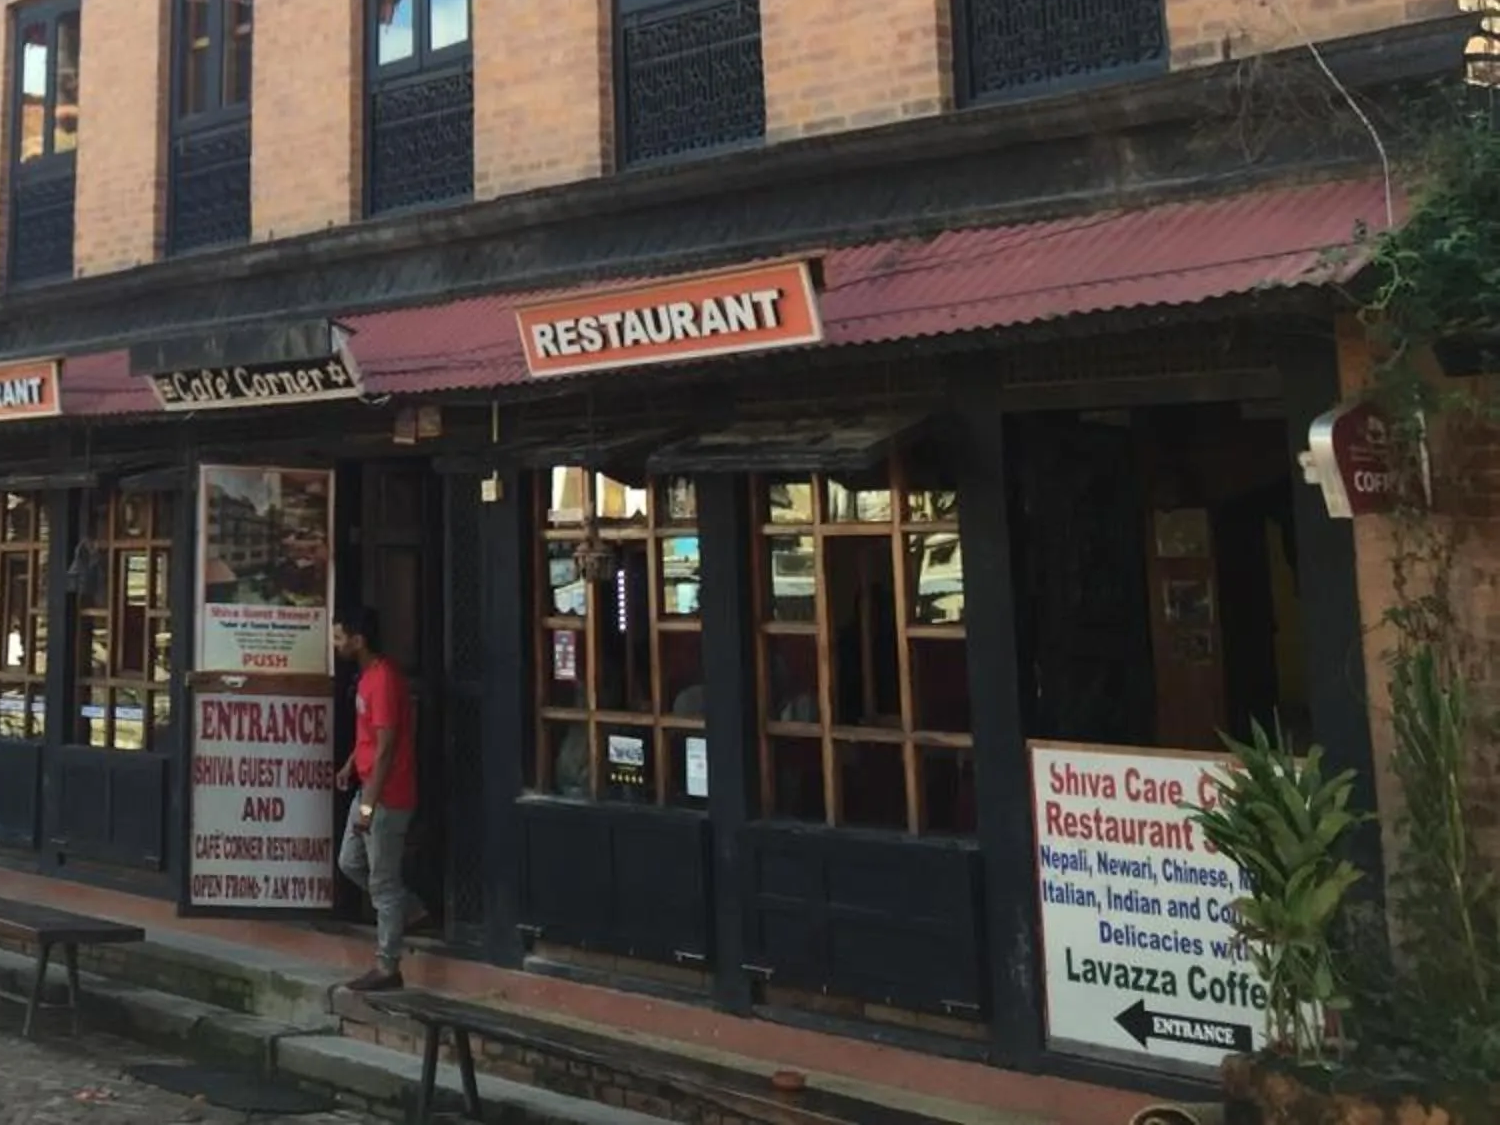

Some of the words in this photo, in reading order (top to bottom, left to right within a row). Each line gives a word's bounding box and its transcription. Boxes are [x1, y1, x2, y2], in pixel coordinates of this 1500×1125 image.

[531, 288, 781, 358] RESTAURANT
[234, 366, 323, 397] Corner
[243, 653, 288, 668] PUSH
[200, 701, 328, 744] ENTRANCE
[193, 755, 235, 787] SHIVA
[239, 758, 284, 788] GUEST
[287, 759, 334, 790] HOUSE
[1050, 763, 1116, 800] Shiva
[241, 796, 285, 822] AND
[1045, 800, 1194, 852] Restaurant
[194, 874, 222, 899] OPEN
[1040, 845, 1092, 878] Nepali,
[1097, 851, 1158, 886] Newari,
[1162, 858, 1233, 893] Chinese,
[1043, 880, 1101, 914] Italian,
[1107, 885, 1161, 916] Indian
[1168, 896, 1200, 920] and
[1100, 921, 1204, 955] Delicacies
[1065, 947, 1178, 997] Lavazza
[1152, 1015, 1236, 1045] ENTRANCE
